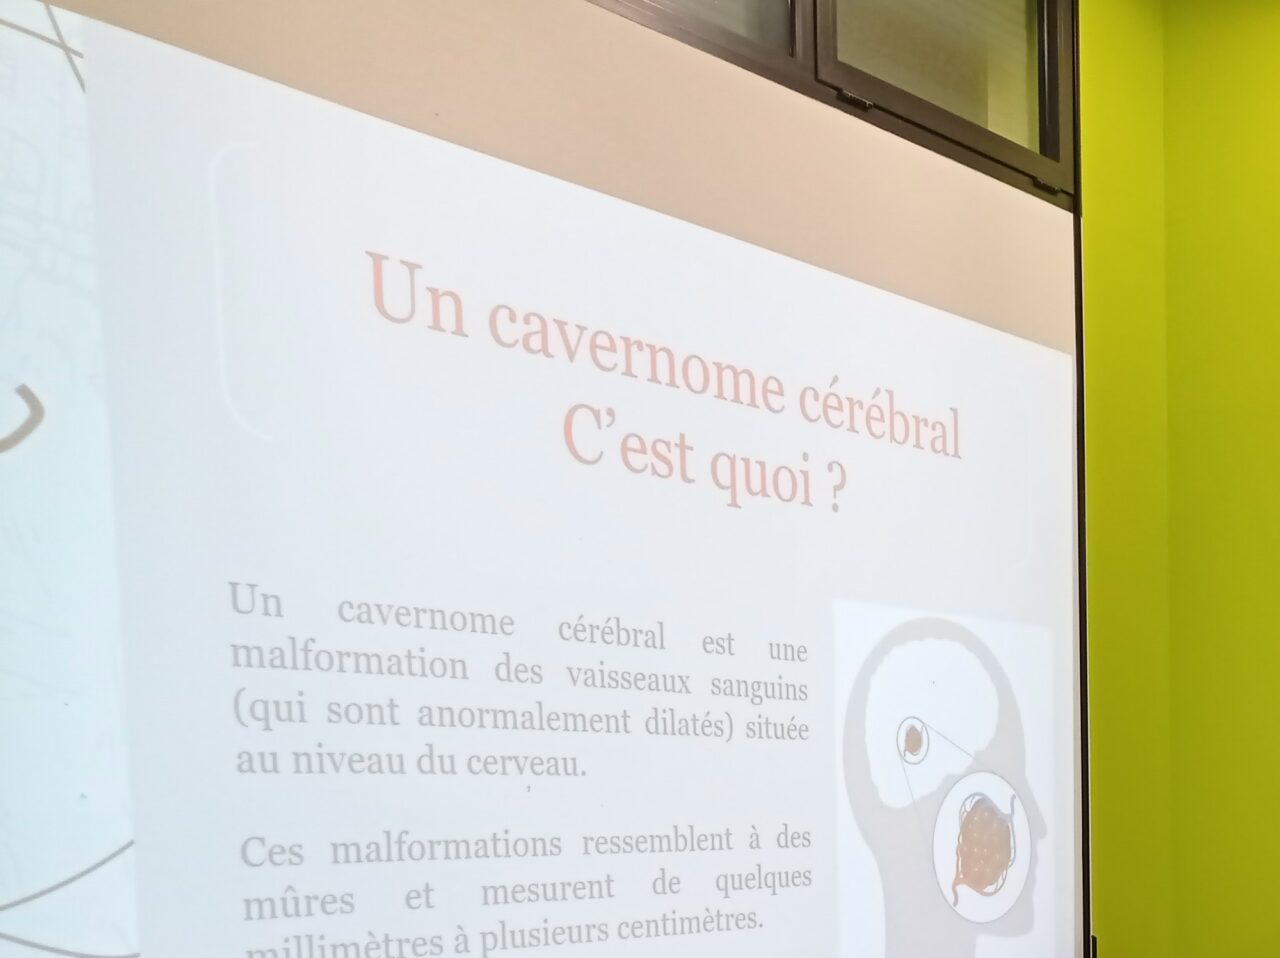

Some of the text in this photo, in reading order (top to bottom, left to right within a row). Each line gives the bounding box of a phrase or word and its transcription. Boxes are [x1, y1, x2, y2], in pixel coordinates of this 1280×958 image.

[365, 250, 963, 460] Un cavernome cérébral
[562, 402, 847, 513] C’est quoi ?
[228, 580, 809, 663] Un cavernome cérébral est une
[230, 635, 809, 706] malformation des vaisseaux sanguins
[233, 687, 810, 743] (qui sont anormalement dilatés) située
[235, 741, 588, 778] au niveau du cerveau.
[239, 822, 812, 868] Ces malformations ressemblent à des
[242, 863, 813, 922] mûres et mesurent de quelques
[453, 923, 472, 955] à
[616, 907, 764, 941] centimètres.
